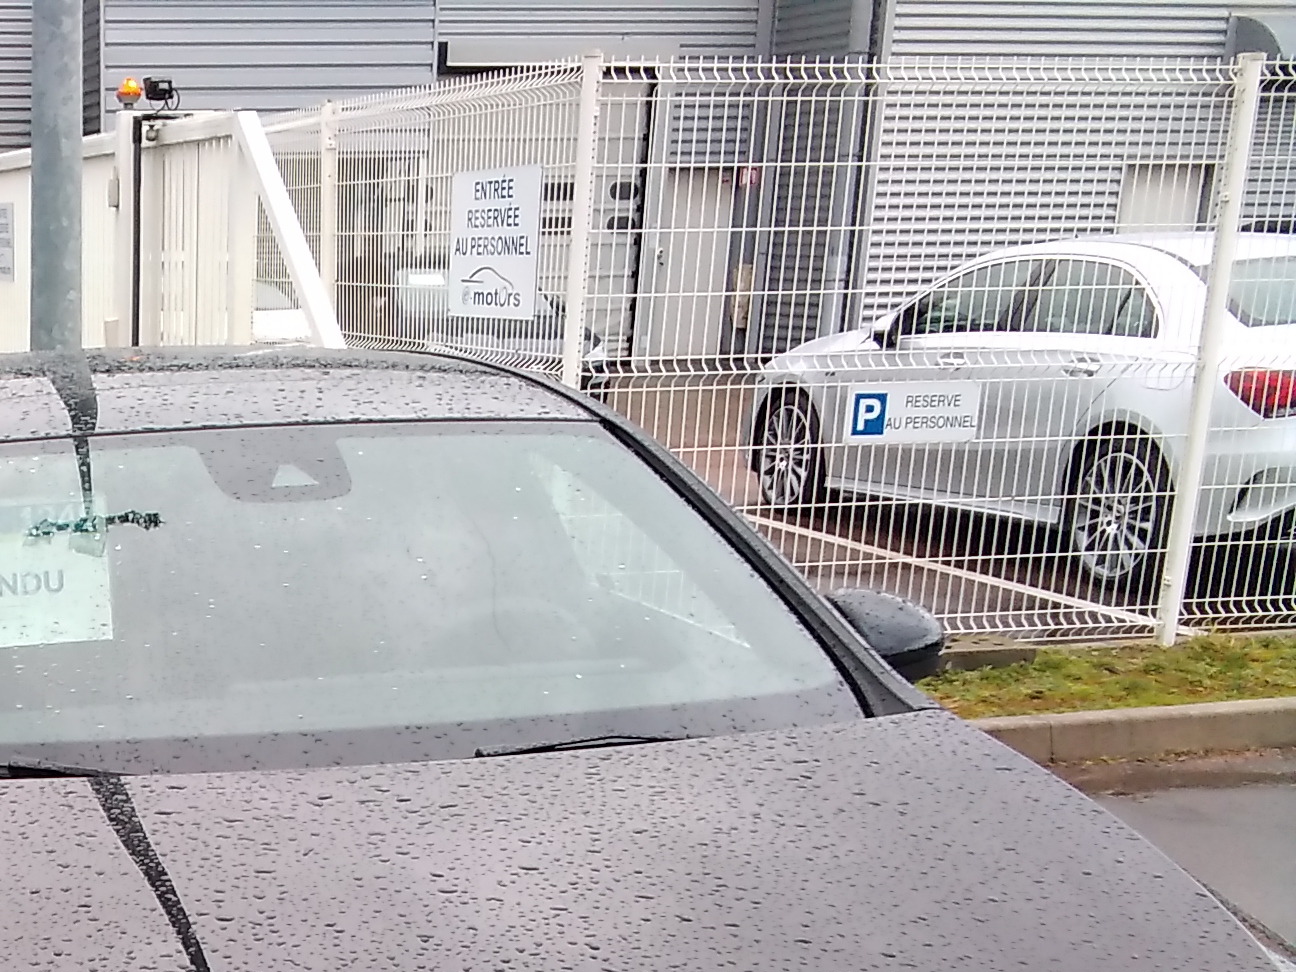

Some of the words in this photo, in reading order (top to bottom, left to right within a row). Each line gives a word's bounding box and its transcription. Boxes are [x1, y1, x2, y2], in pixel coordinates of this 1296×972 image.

[474, 175, 514, 200] ENTRÉE
[467, 203, 520, 229] RESERVÉE
[454, 237, 468, 255] AU
[470, 236, 531, 256] PERSONNEL
[905, 394, 962, 409] RESERVE
[856, 398, 881, 431] P
[885, 417, 902, 430] AU
[905, 415, 976, 430] PERSONNEL
